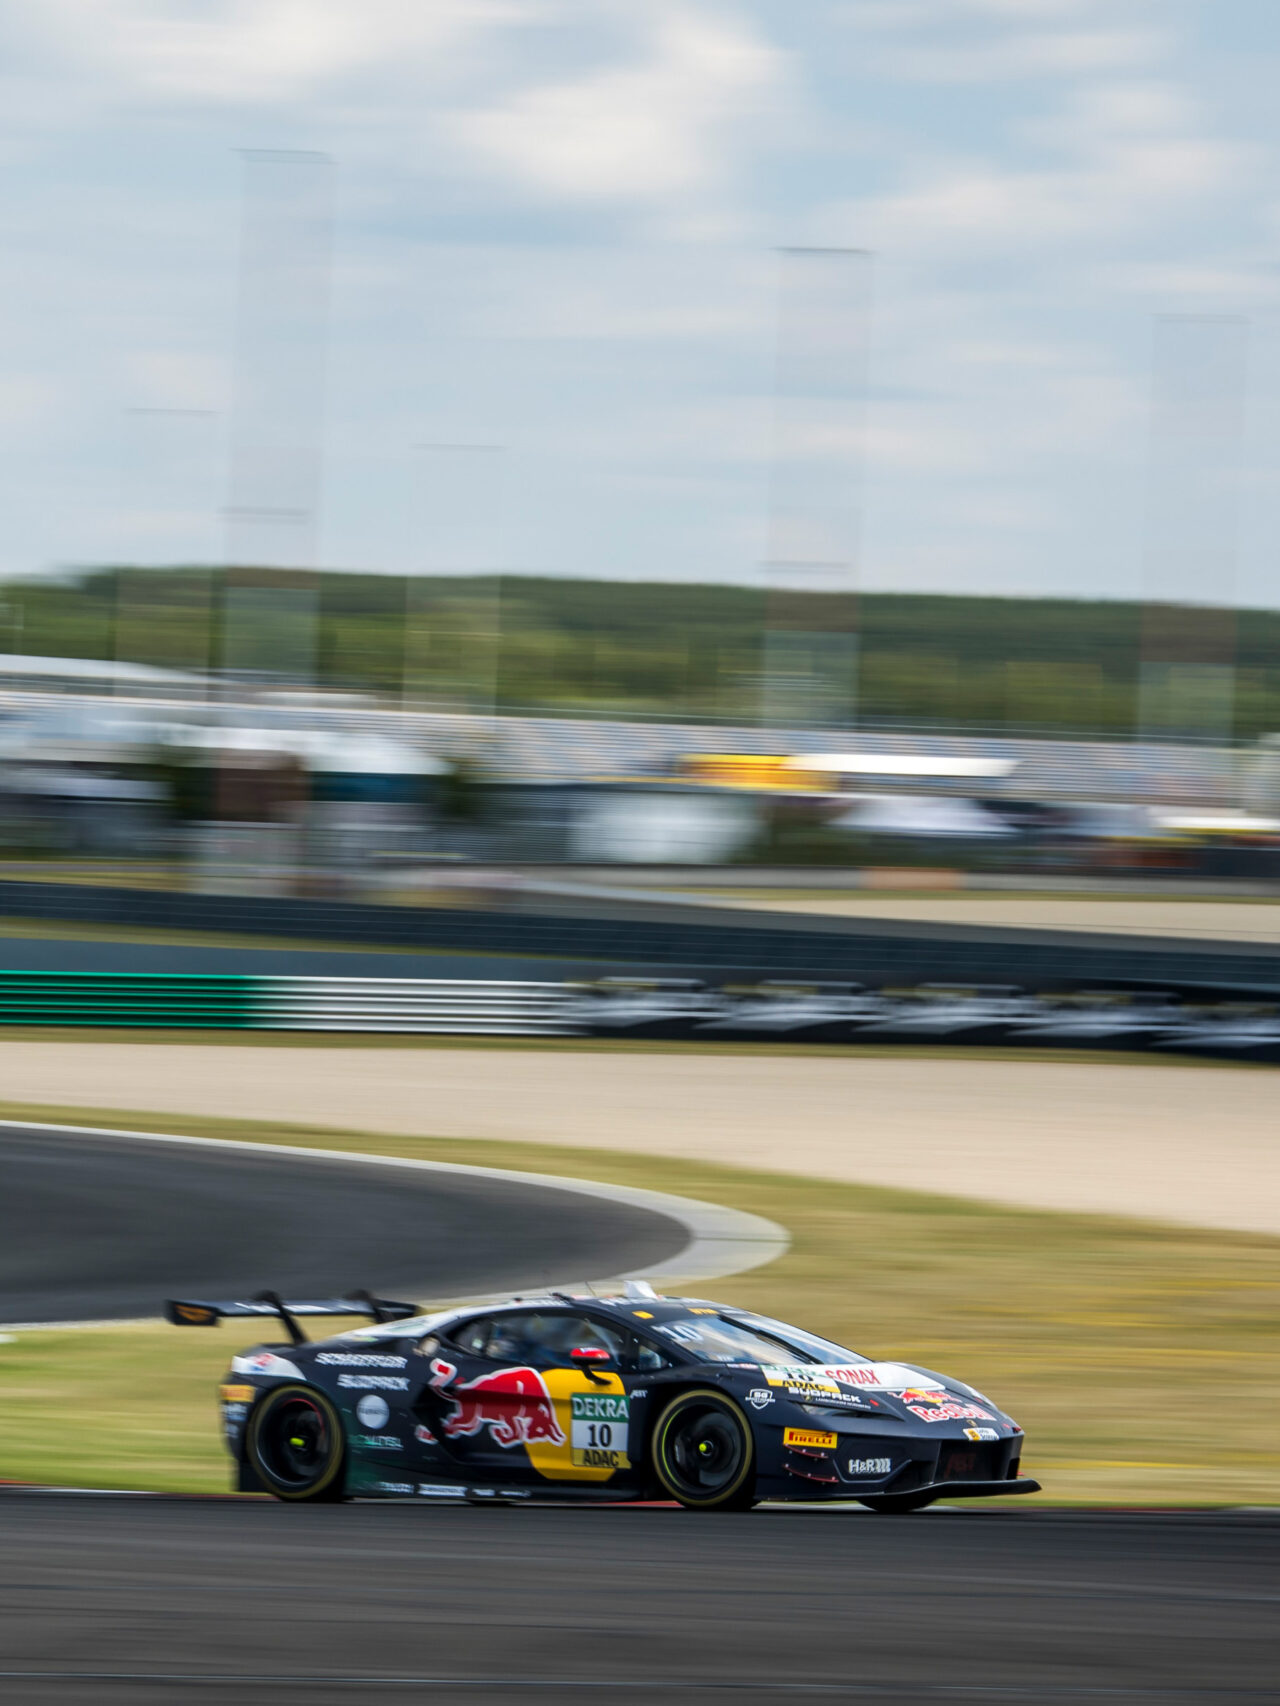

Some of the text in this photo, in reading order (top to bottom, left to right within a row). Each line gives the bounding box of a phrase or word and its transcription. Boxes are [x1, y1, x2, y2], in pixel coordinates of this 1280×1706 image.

[651, 1323, 703, 1343] 10
[825, 1369, 881, 1385] SONAX
[572, 1397, 630, 1419] DEKRA
[588, 1424, 612, 1448] 10
[789, 1431, 833, 1445] PIRELLI
[583, 1449, 619, 1467] ADAC
